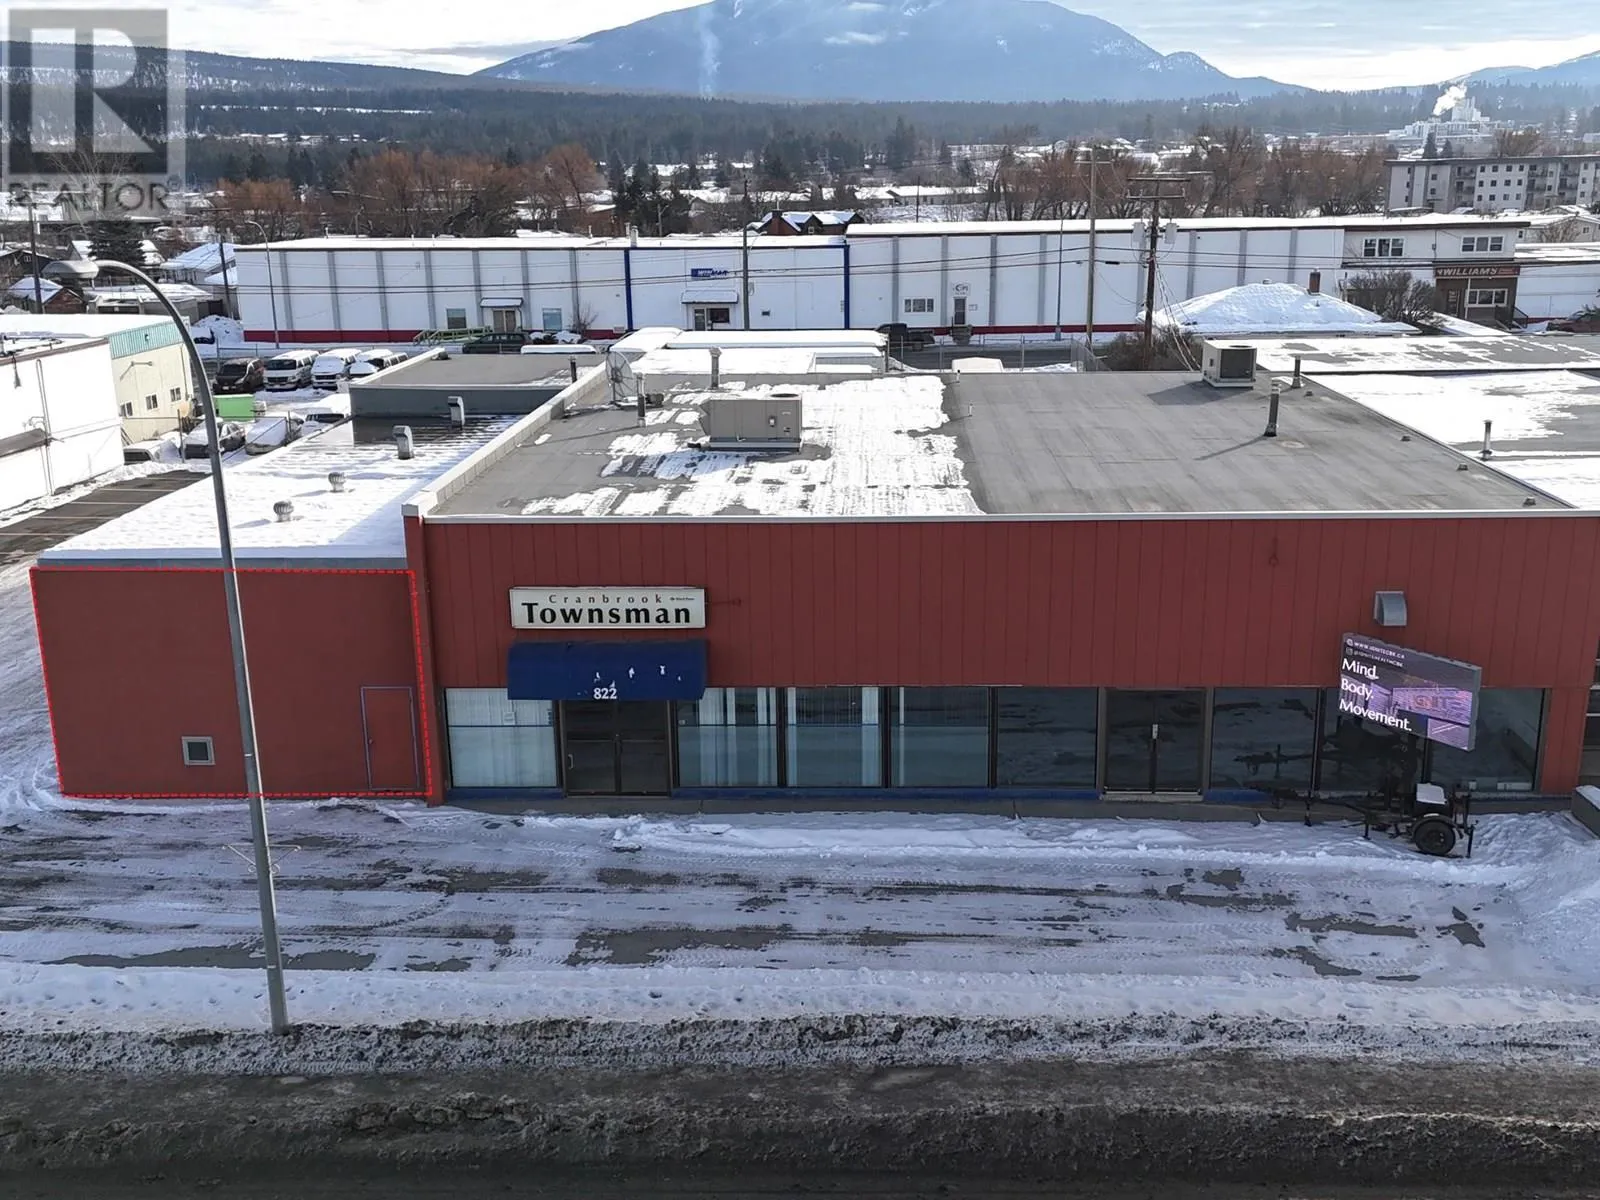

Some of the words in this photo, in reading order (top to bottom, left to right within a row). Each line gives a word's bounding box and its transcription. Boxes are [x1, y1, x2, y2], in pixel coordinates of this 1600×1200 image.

[548, 594, 662, 604] Cranbrook
[521, 602, 691, 624] Townsman
[1342, 657, 1379, 679] Mind.
[593, 687, 617, 700] 822
[1340, 678, 1374, 700] Body.
[1339, 698, 1412, 732] Movement.
